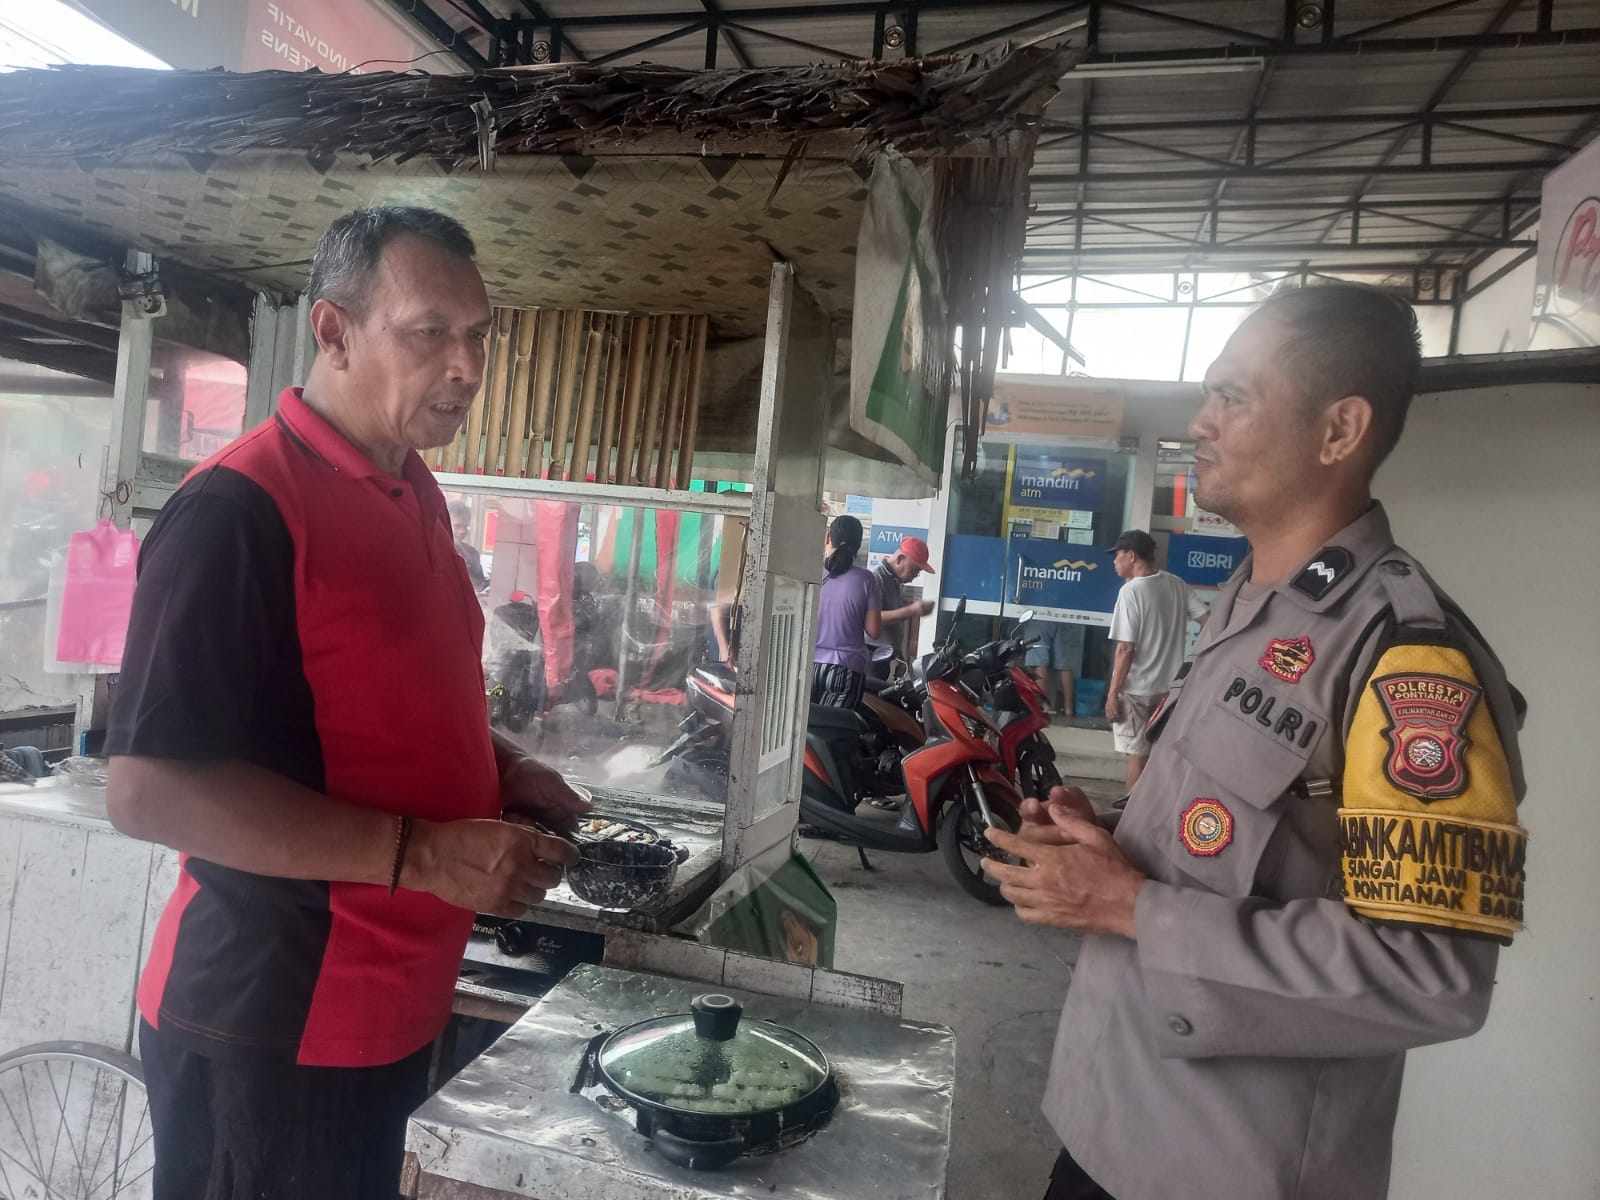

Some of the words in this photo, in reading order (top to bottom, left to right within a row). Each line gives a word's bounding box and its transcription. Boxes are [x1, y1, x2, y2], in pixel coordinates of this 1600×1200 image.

[1021, 475, 1080, 490] mandiri
[1020, 488, 1042, 498] atm
[877, 530, 903, 543] ATM
[1205, 553, 1233, 569] BRI
[1023, 566, 1081, 582] mandiri
[1021, 579, 1043, 590] atm
[1388, 681, 1464, 702] POLRESTA
[1395, 690, 1458, 706] PONTIANAK
[1223, 676, 1317, 749] POLRI
[1348, 859, 1400, 881] SUNGAI
[1415, 864, 1467, 890] JAWI
[1480, 873, 1525, 900] DALA
[1353, 879, 1465, 911] PONTIANAK
